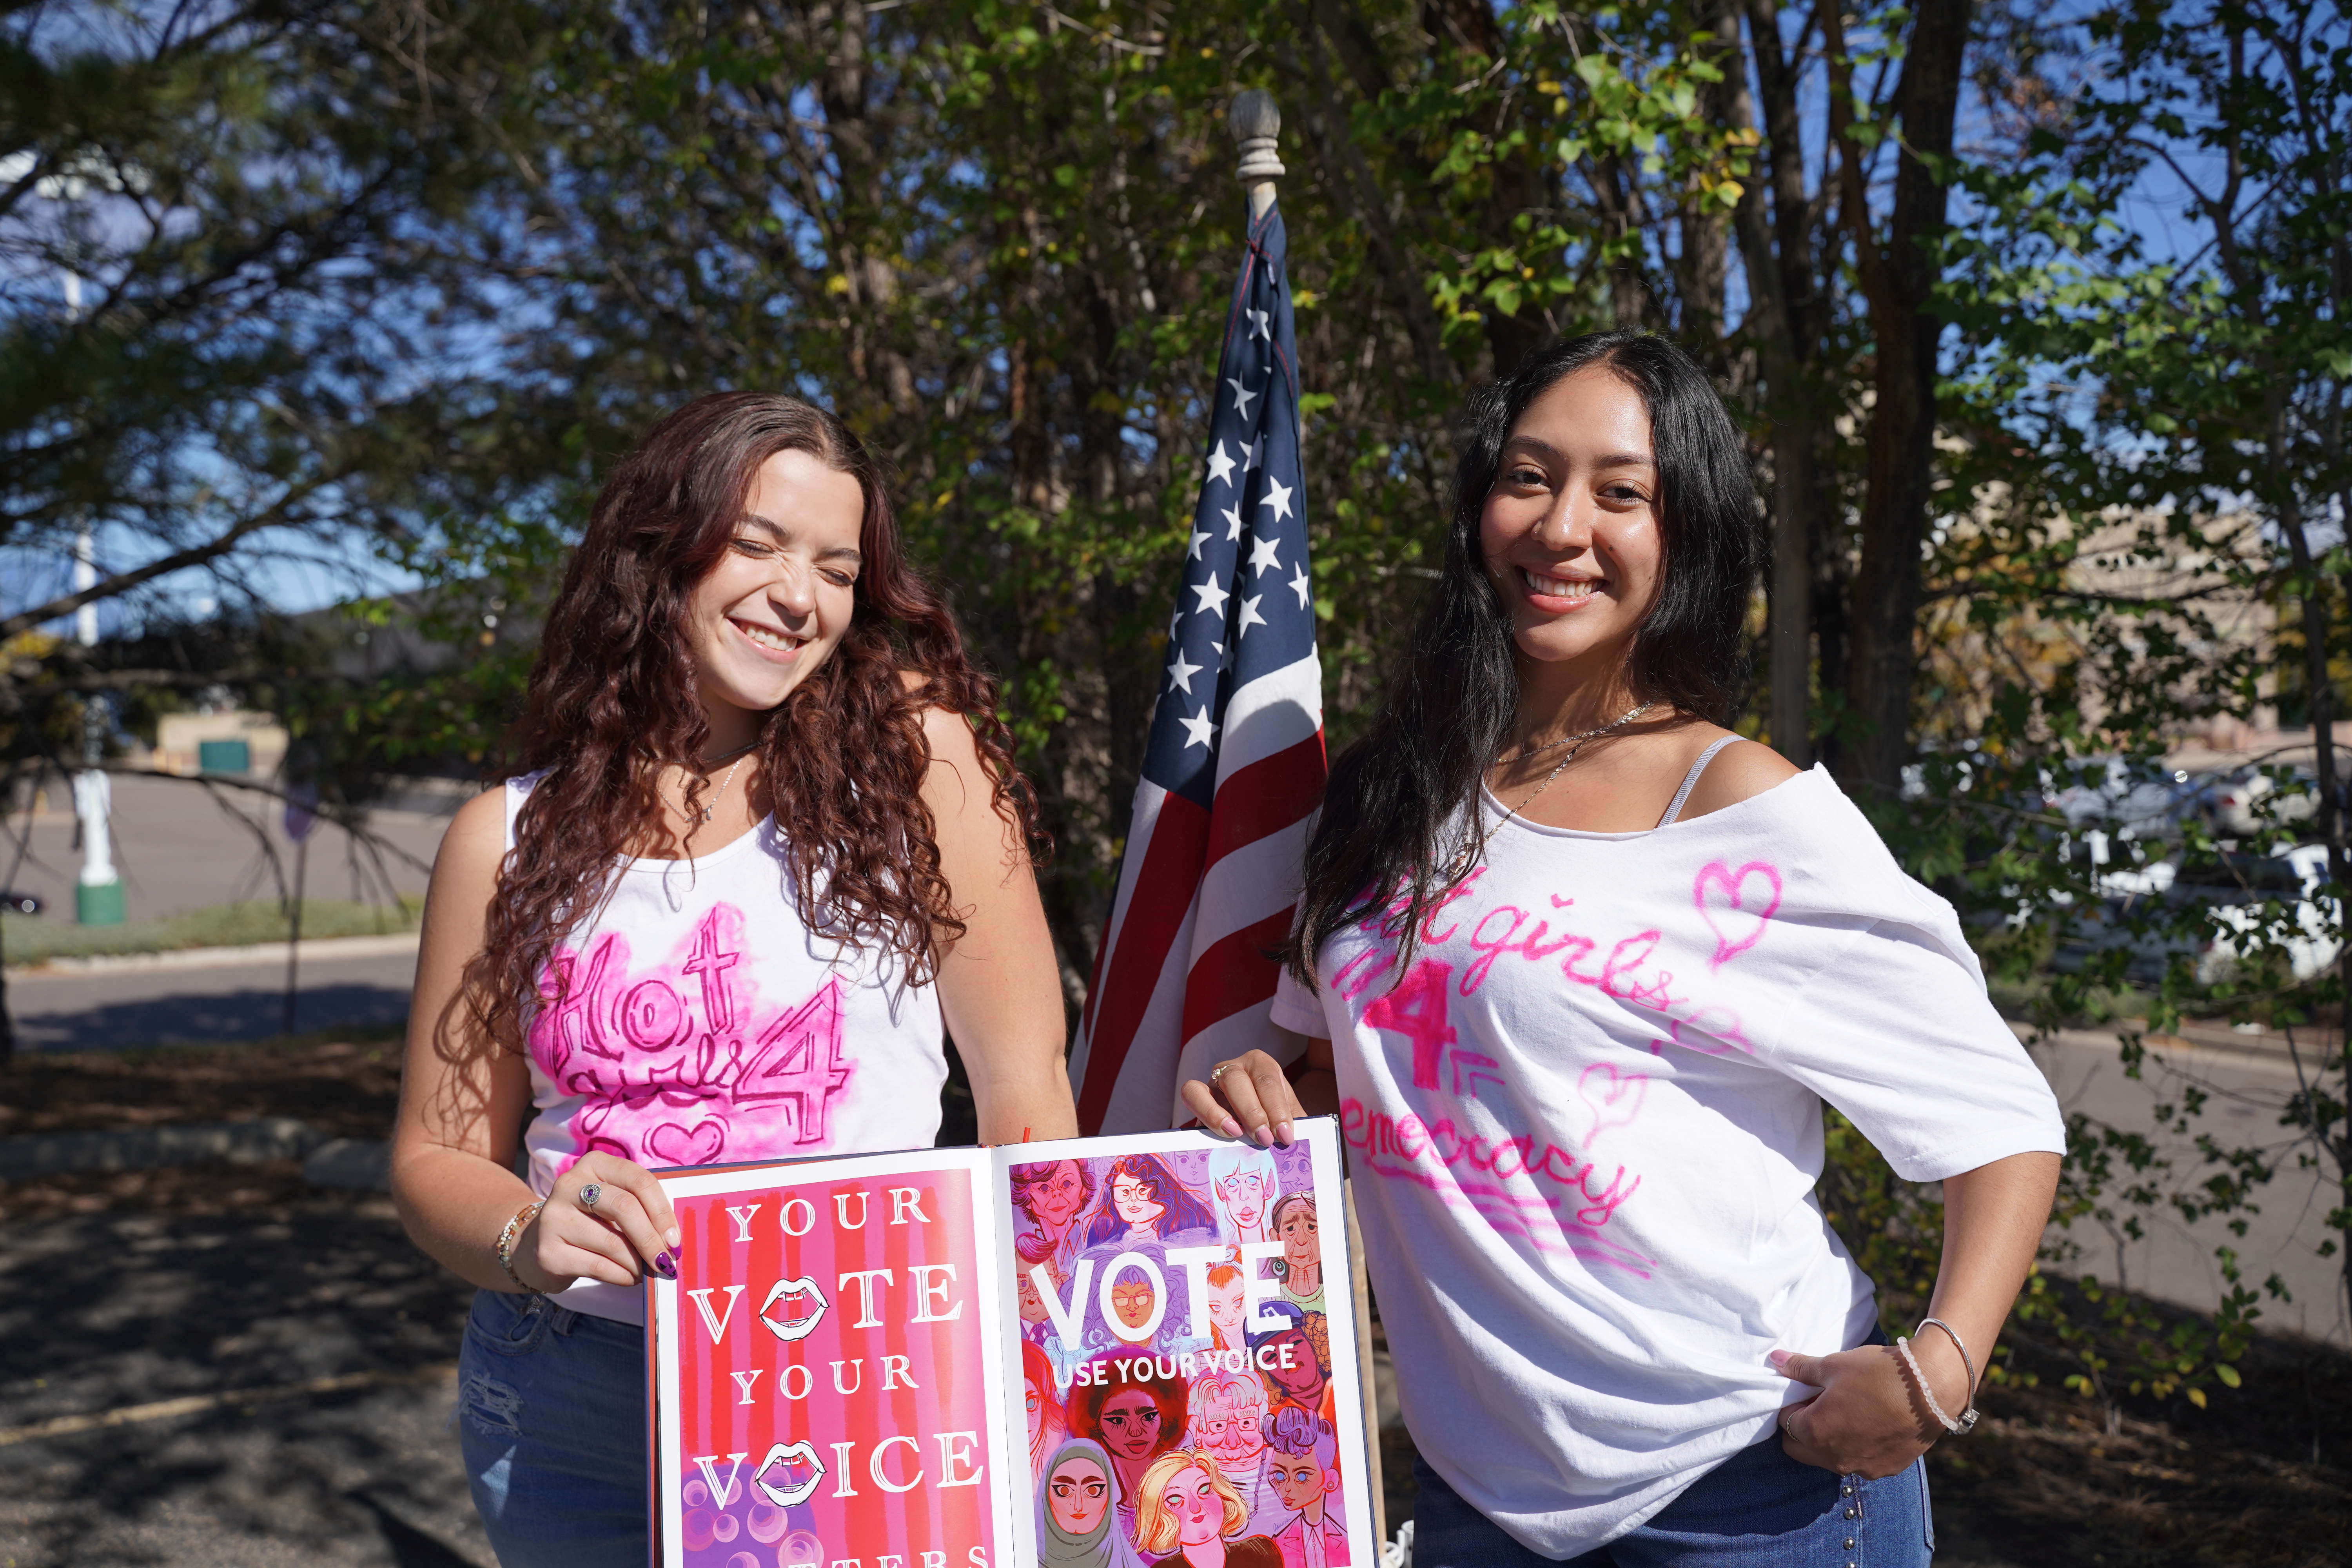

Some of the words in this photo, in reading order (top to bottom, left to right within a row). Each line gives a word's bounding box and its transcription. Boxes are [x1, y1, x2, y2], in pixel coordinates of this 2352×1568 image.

[548, 906, 741, 1078] Hot
[1459, 894, 1689, 1012] girls
[732, 979, 850, 1144] 4
[1363, 956, 1456, 1091] 4
[725, 1187, 931, 1242] YOUR
[1028, 1240, 1293, 1352] VOTE
[730, 1354, 919, 1405] YOUR
[1052, 1359, 1109, 1390] USE
[1115, 1351, 1197, 1384] YOUR
[1203, 1343, 1297, 1376] VOICE
